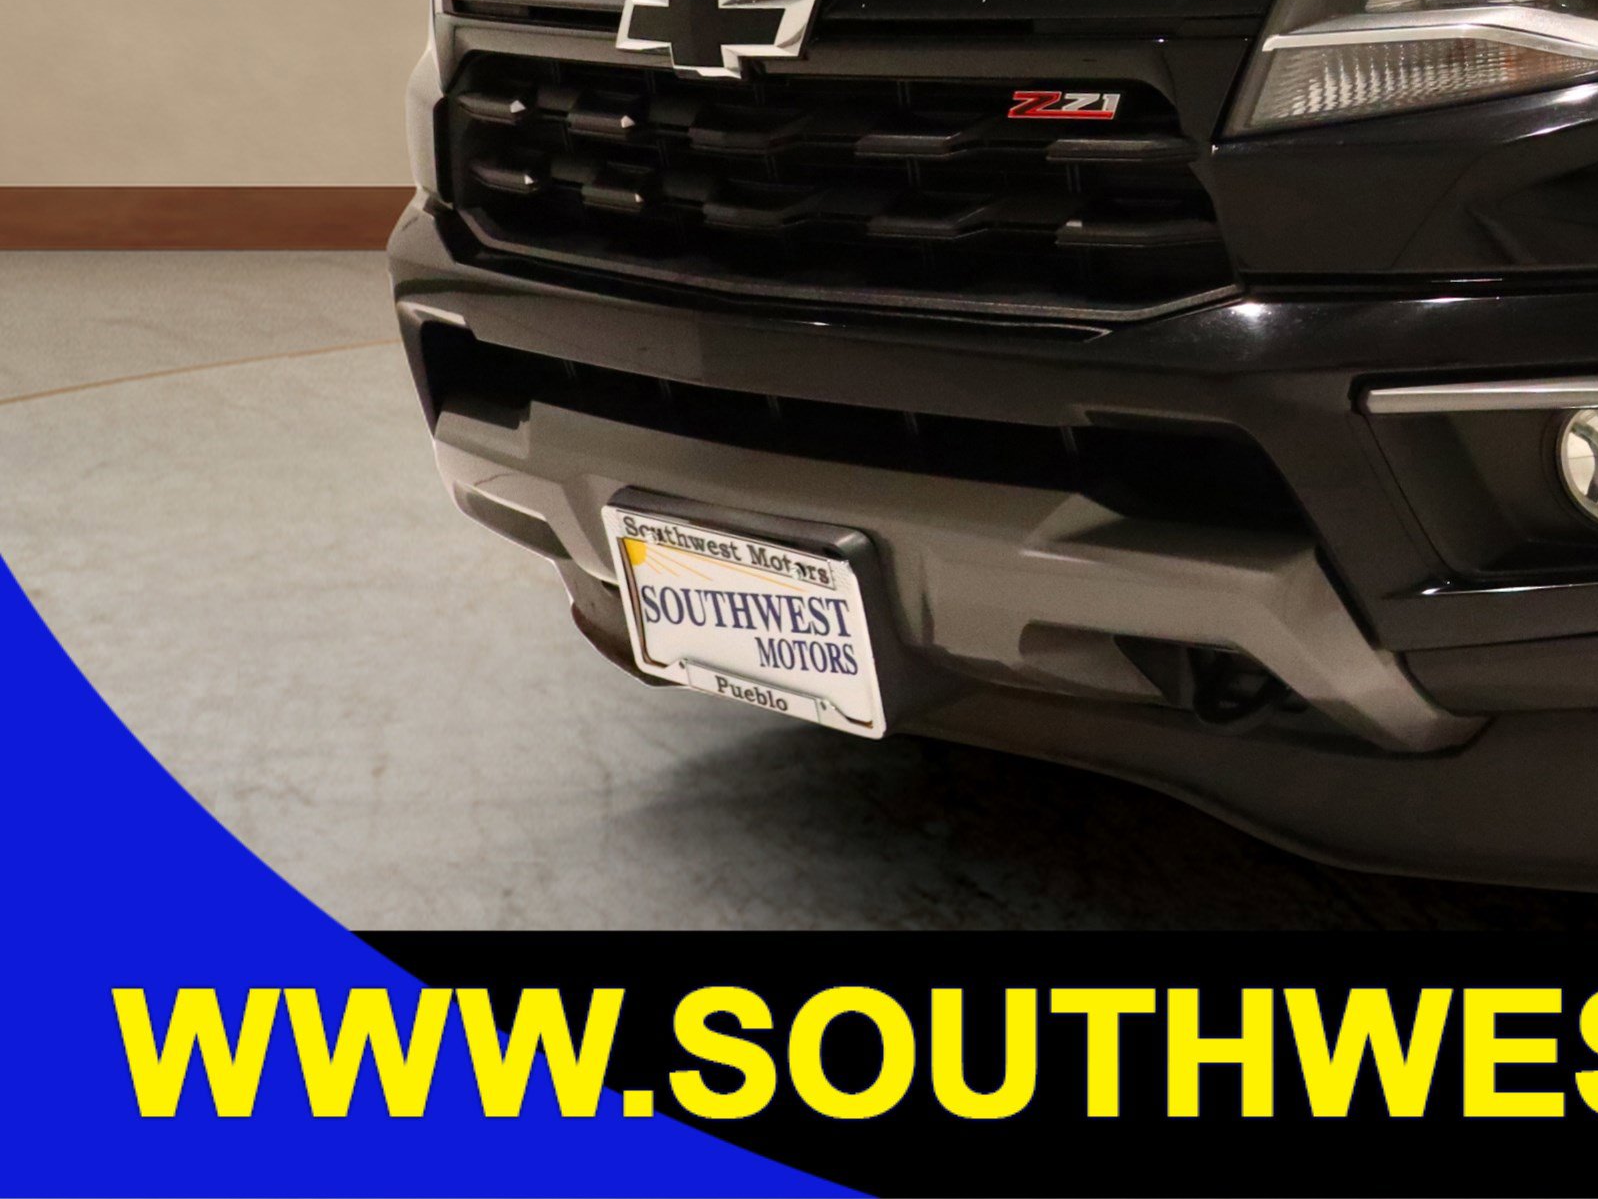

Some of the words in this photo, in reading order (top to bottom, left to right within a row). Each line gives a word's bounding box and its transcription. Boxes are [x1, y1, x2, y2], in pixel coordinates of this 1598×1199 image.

[1007, 90, 1121, 120] Z71
[640, 585, 851, 638] SOUTHWEST
[755, 637, 858, 676] MOTORS
[715, 675, 788, 711] Pueblo
